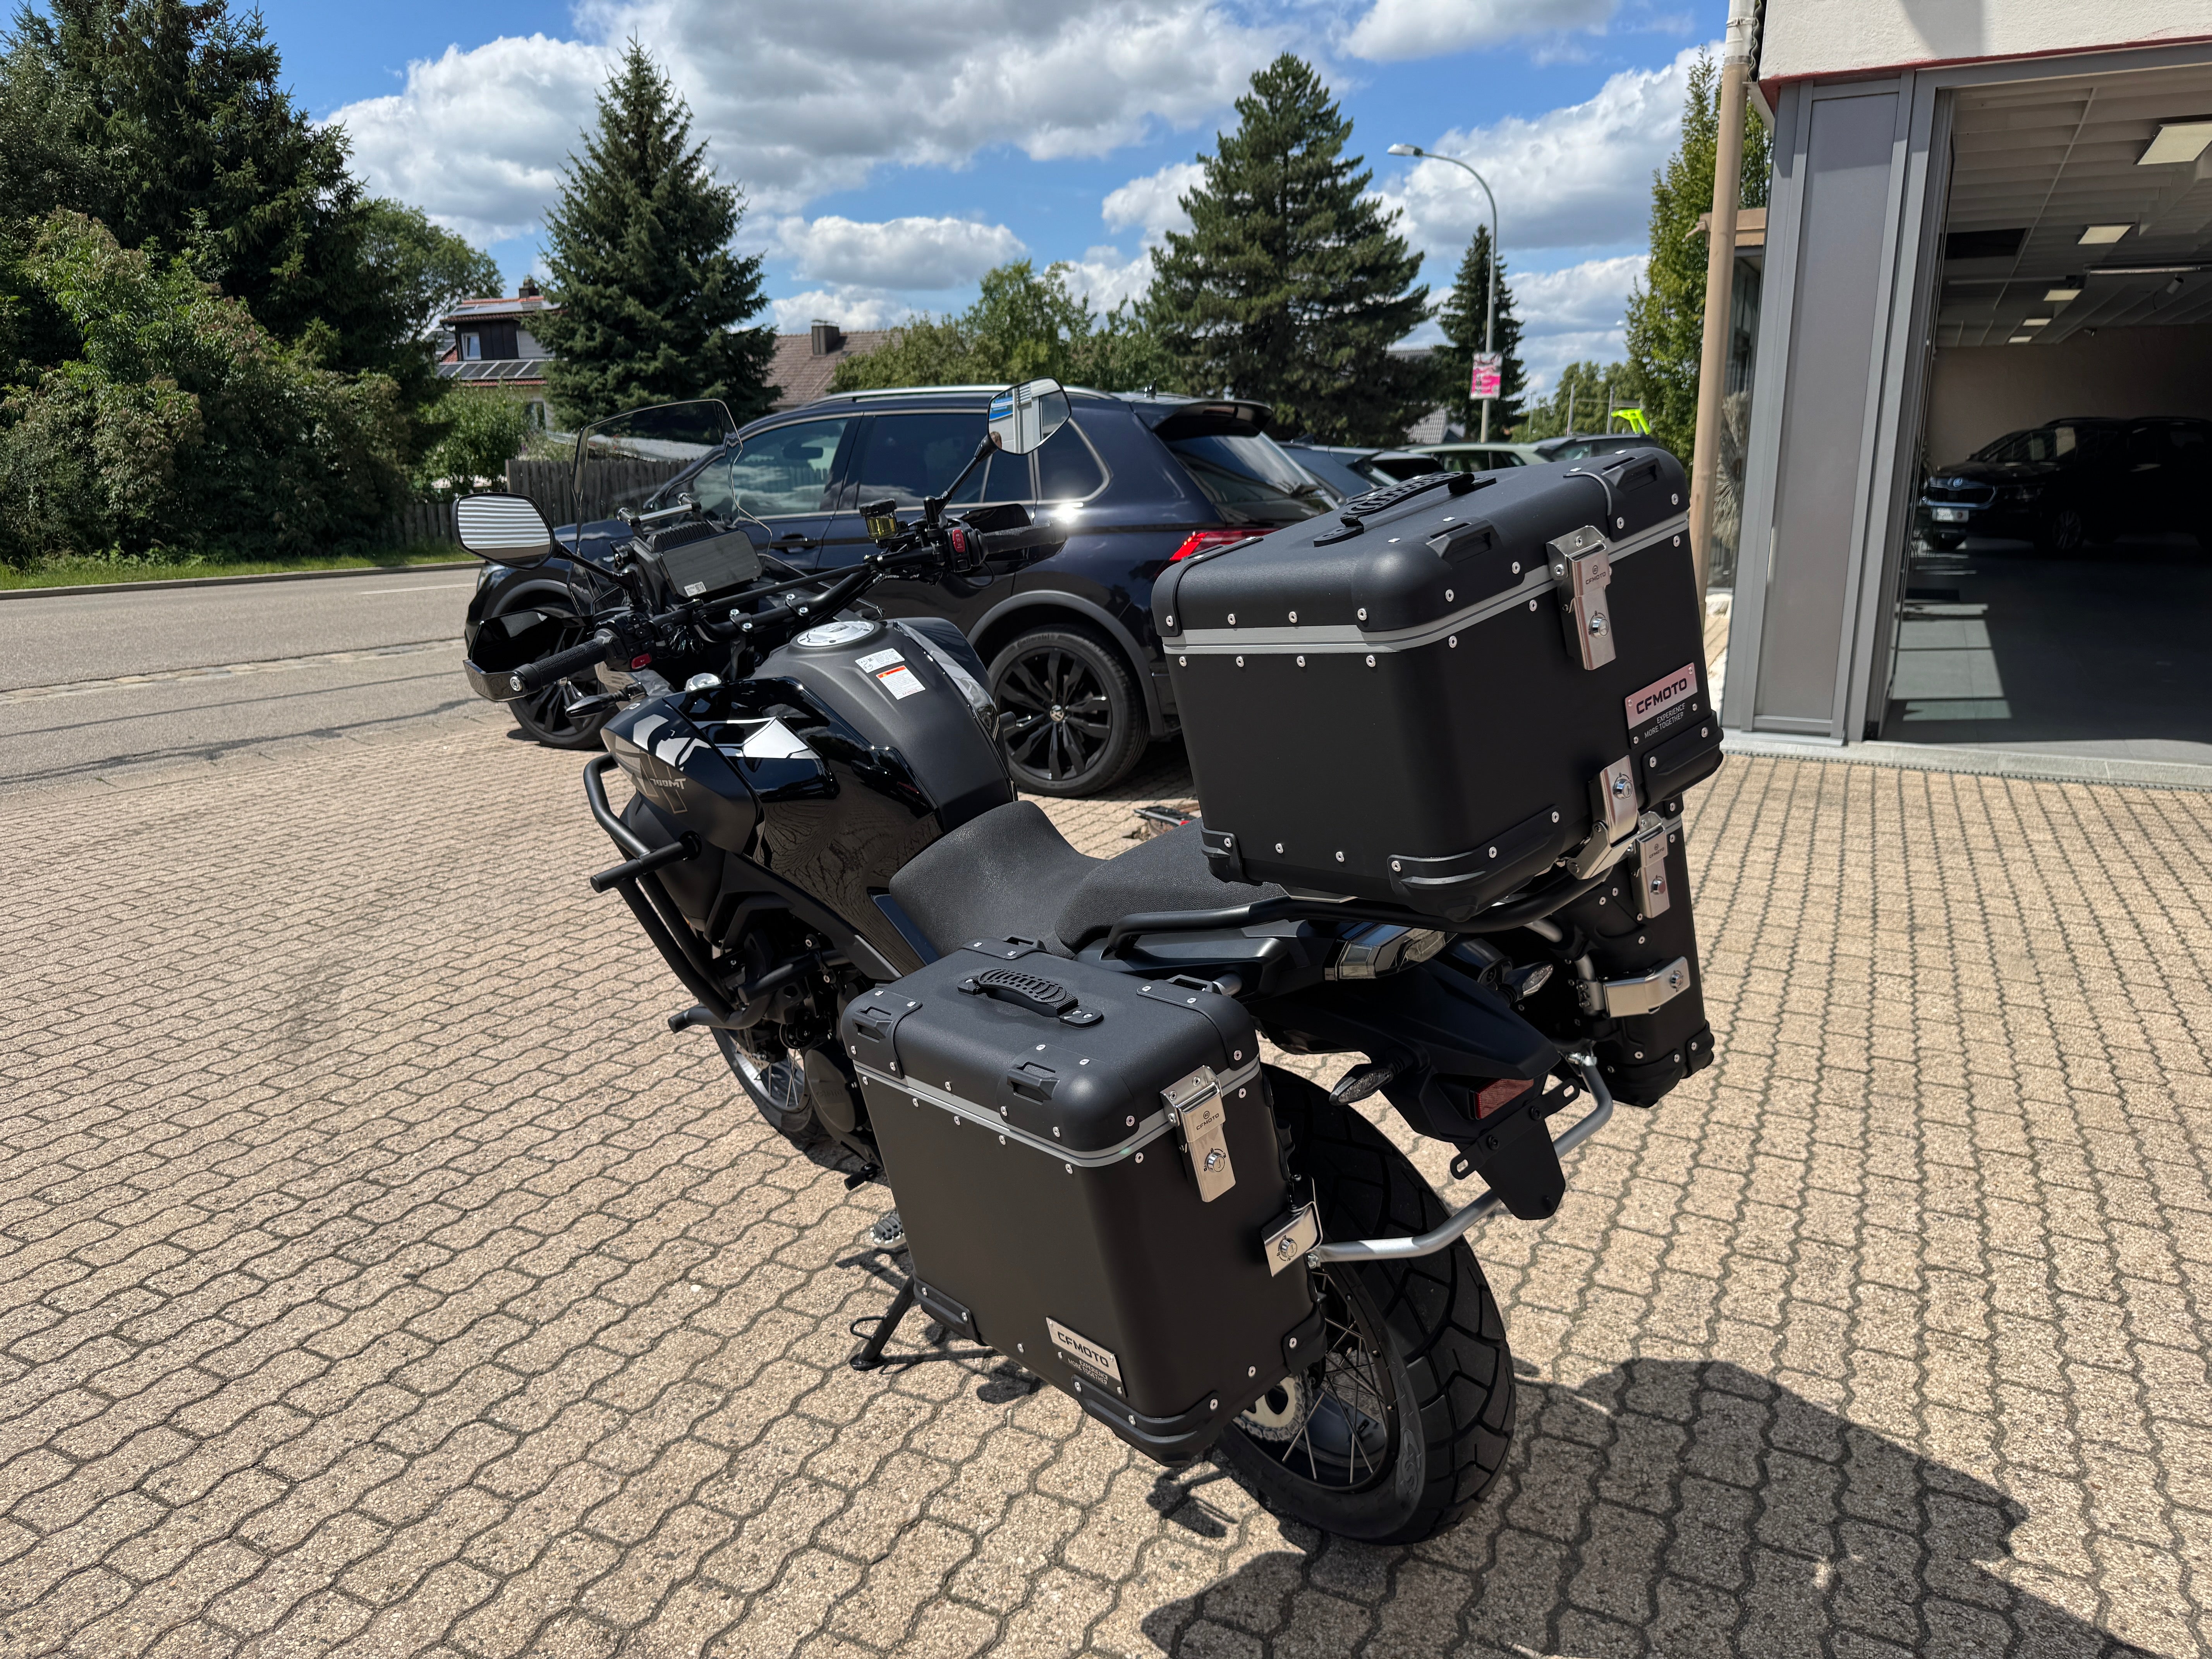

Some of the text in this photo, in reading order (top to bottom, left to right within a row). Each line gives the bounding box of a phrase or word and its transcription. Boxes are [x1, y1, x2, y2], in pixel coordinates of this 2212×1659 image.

[1585, 571, 1606, 585] CFMOTO
[1636, 678, 1687, 714] CFMOTO
[1657, 703, 1685, 723] EXPERIENCE
[1645, 711, 1684, 738] MORE TOGETHER
[650, 778, 686, 789] 700MT
[1649, 847, 1664, 858] CFMOTO
[1196, 1113, 1219, 1130] CFMOTO
[1058, 1331, 1109, 1367] CFMOTO
[1068, 1358, 1108, 1385] MORE TOGETHER
[1079, 1360, 1108, 1381] EXPERIENCE
